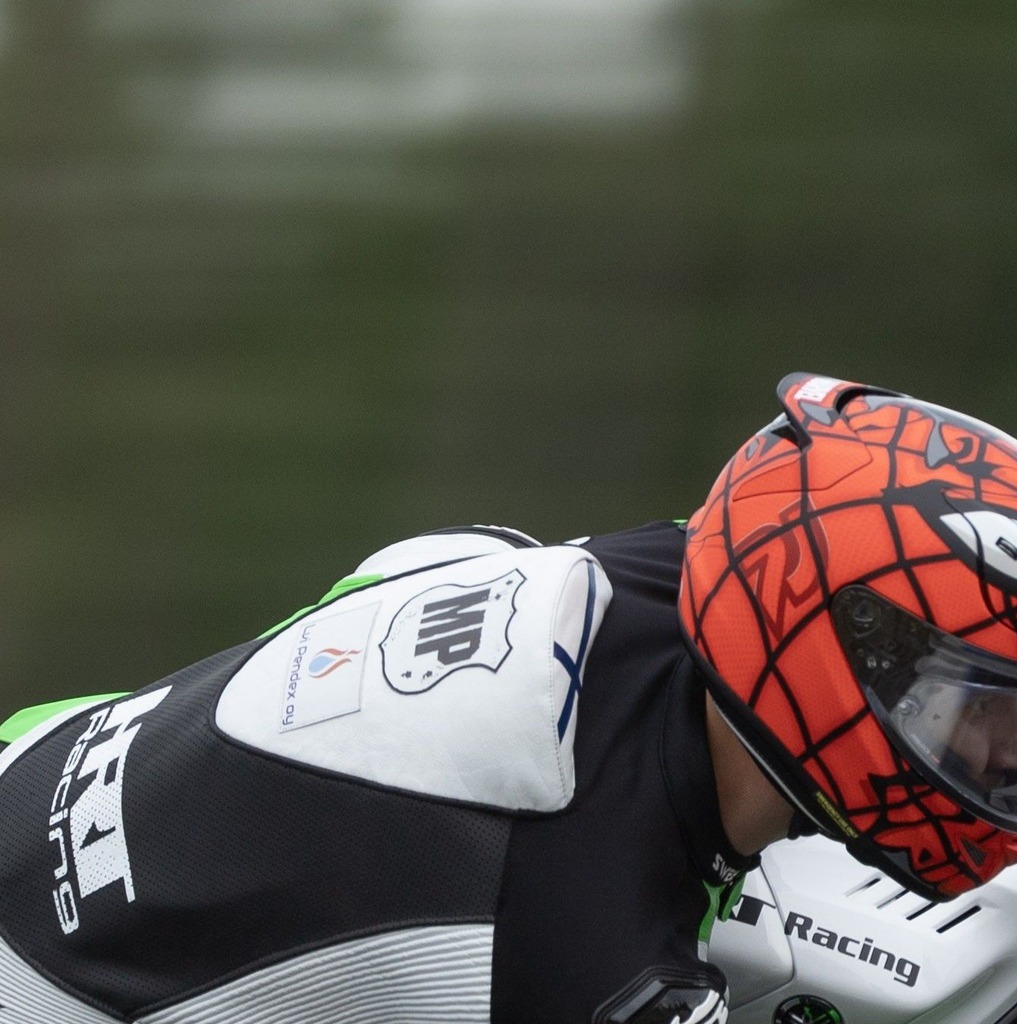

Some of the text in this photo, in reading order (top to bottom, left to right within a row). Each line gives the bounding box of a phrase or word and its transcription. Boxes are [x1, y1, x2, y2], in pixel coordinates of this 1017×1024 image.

[414, 588, 491, 666] MP
[49, 707, 111, 935] Racing
[784, 911, 921, 988] Racing
